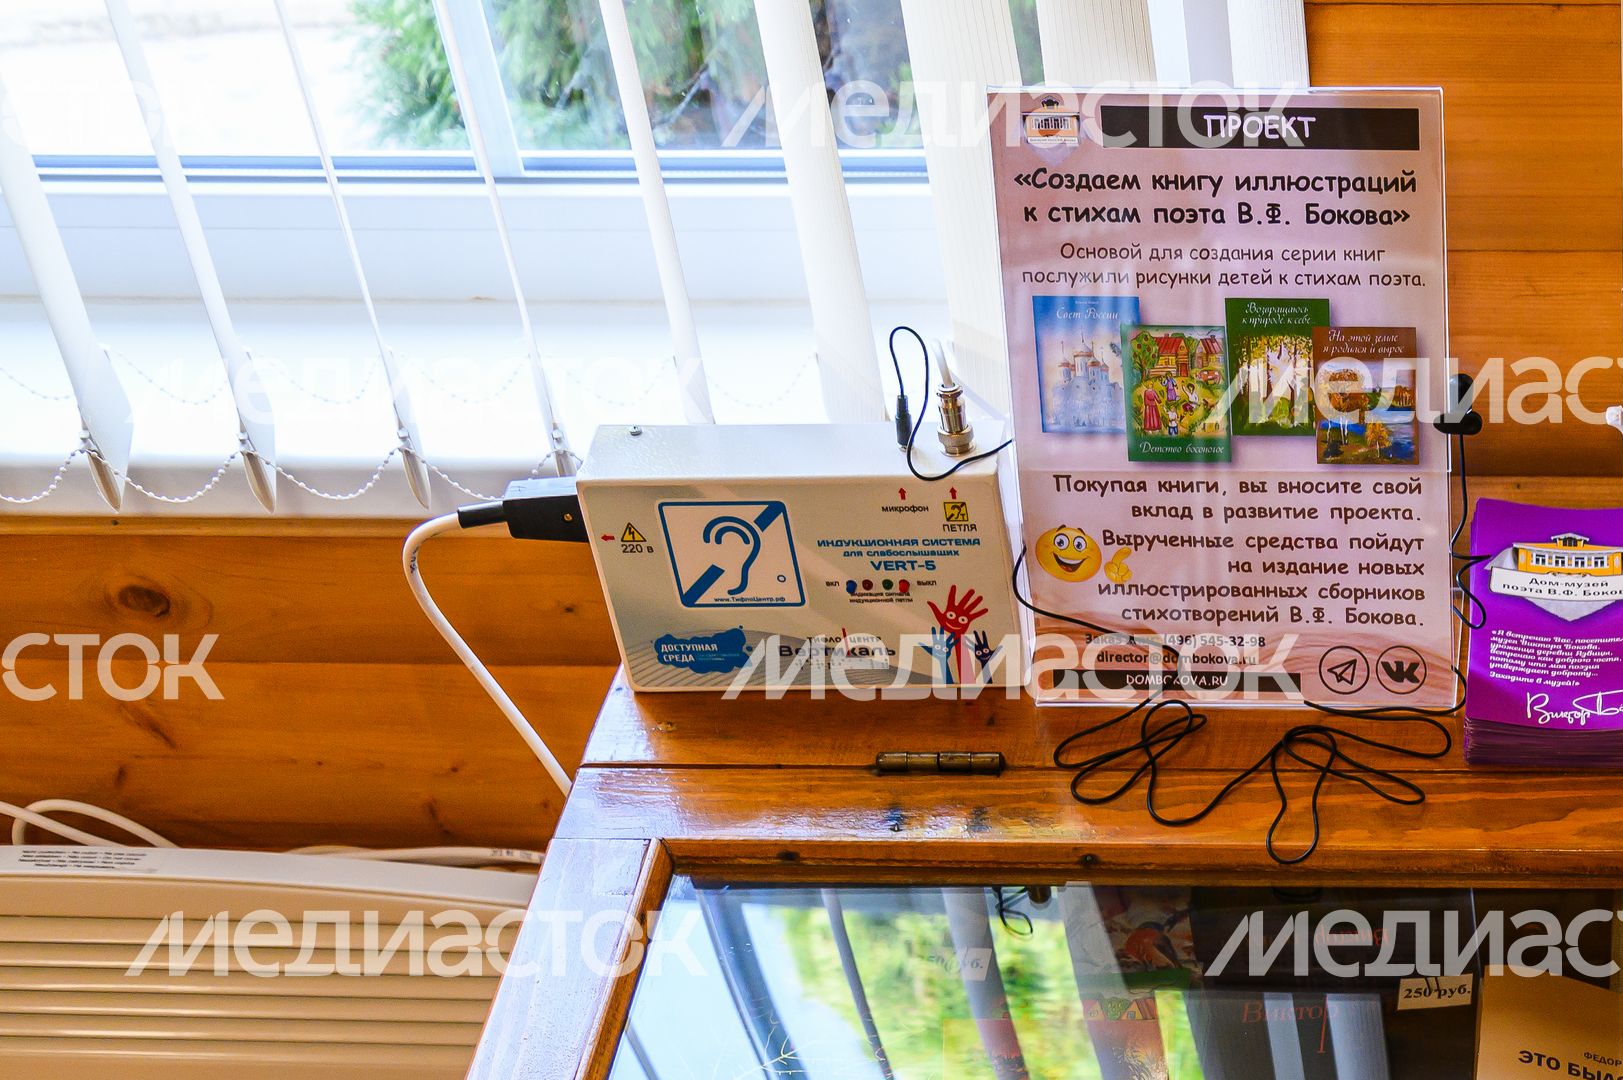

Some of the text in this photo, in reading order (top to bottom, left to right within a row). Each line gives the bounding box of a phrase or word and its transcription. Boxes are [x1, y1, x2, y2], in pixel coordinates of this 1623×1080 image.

[1203, 114, 1317, 140] ПРОЕКТ
[1014, 167, 1418, 199] «Создаем книгу иллюстраций
[1024, 206, 1037, 223] к
[1047, 206, 1141, 225] стихам
[1153, 207, 1226, 226] поэта
[1305, 203, 1411, 227] Бокова»
[1060, 242, 1386, 267] Основой для создания серии книг
[1022, 267, 1426, 290] послужили рисунки детей к стихам поэта.
[1053, 475, 1423, 499] Покупая книги, вы вносите свой
[882, 505, 929, 513] микрофон
[1131, 505, 1422, 526] вклад в развитие проекта.
[943, 524, 978, 532] ПЕТЛЯ
[621, 544, 643, 554] 220
[817, 538, 981, 548] ИНДУКЦИОННАЯ СИСТЕМА
[1103, 528, 1425, 556] Вырученные средства пойдут
[870, 560, 937, 572] VERT-5
[1228, 559, 1425, 577] на издание новых
[1502, 583, 1544, 595] поэта
[1528, 576, 1610, 588] Дом-музей
[1098, 582, 1426, 603] иллюстрированных сборников
[1122, 604, 1279, 627] стихотворений
[1345, 607, 1424, 627] Бокова.
[660, 643, 718, 653] ДОСТУПНАЯ
[1163, 634, 1267, 648] (496) 545-32-98
[663, 654, 695, 663] СРЕДА
[778, 645, 897, 658] Вертикаль
[1517, 1049, 1562, 1071] ЭТО
[1583, 1050, 1621, 1066] ФЕДОР
